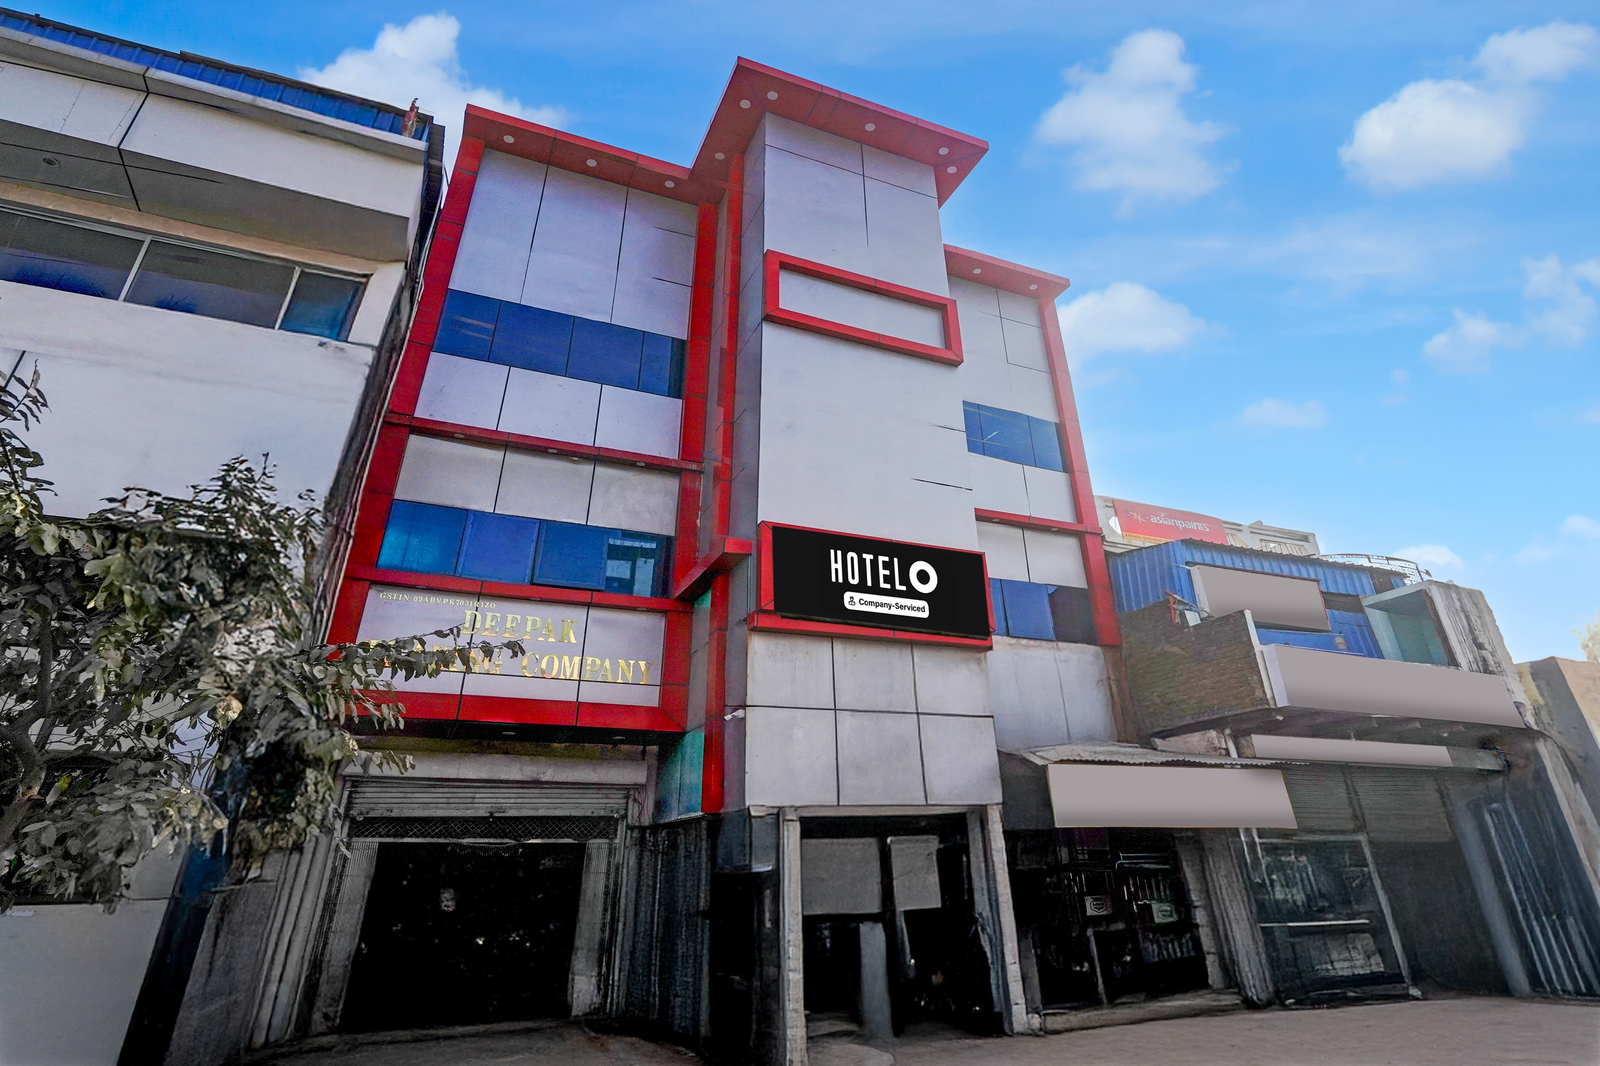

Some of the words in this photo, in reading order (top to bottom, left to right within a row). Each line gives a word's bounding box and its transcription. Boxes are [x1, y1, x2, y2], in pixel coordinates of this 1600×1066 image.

[830, 549, 907, 591] HOTEL
[858, 598, 926, 613] Company-Serviced
[460, 610, 579, 644] DEEPAK
[521, 652, 655, 684] COMPANY
